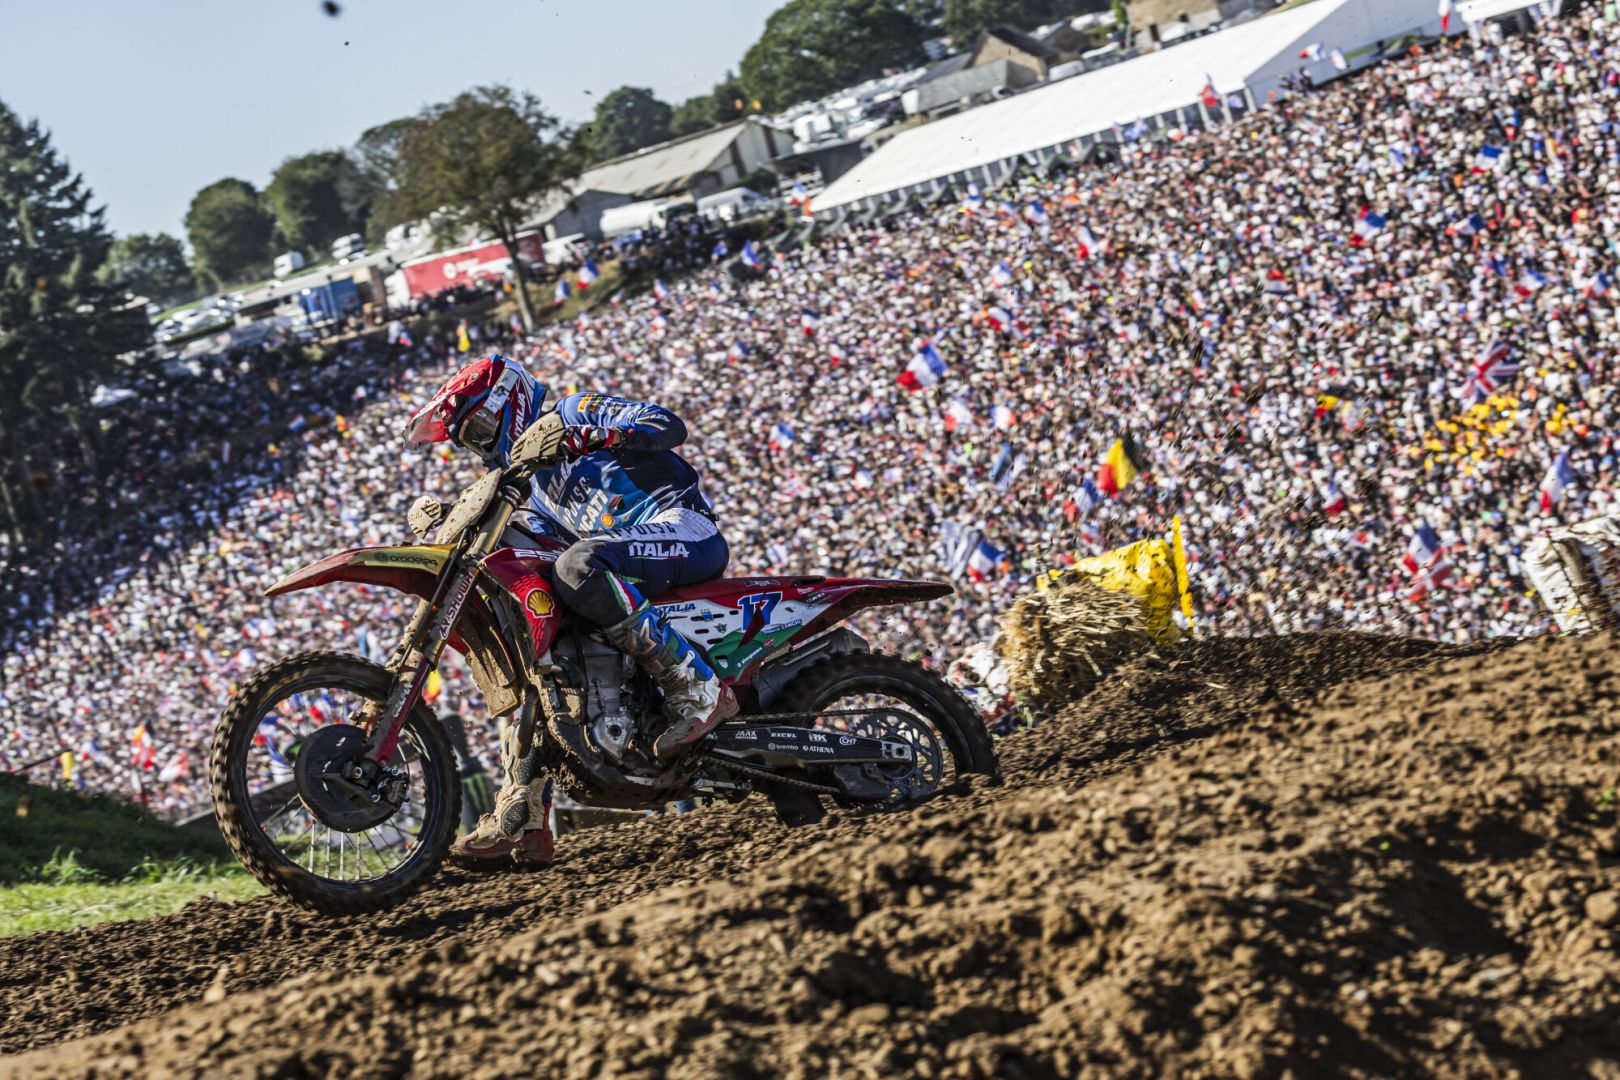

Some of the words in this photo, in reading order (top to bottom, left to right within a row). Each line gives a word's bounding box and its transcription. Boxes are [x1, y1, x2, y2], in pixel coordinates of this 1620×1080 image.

[628, 542, 690, 558] ITALIA
[447, 573, 475, 622] SHOWA
[737, 591, 783, 633] 17
[809, 733, 827, 743] RK
[776, 743, 799, 751] brembo
[808, 746, 835, 754] ATHENA
